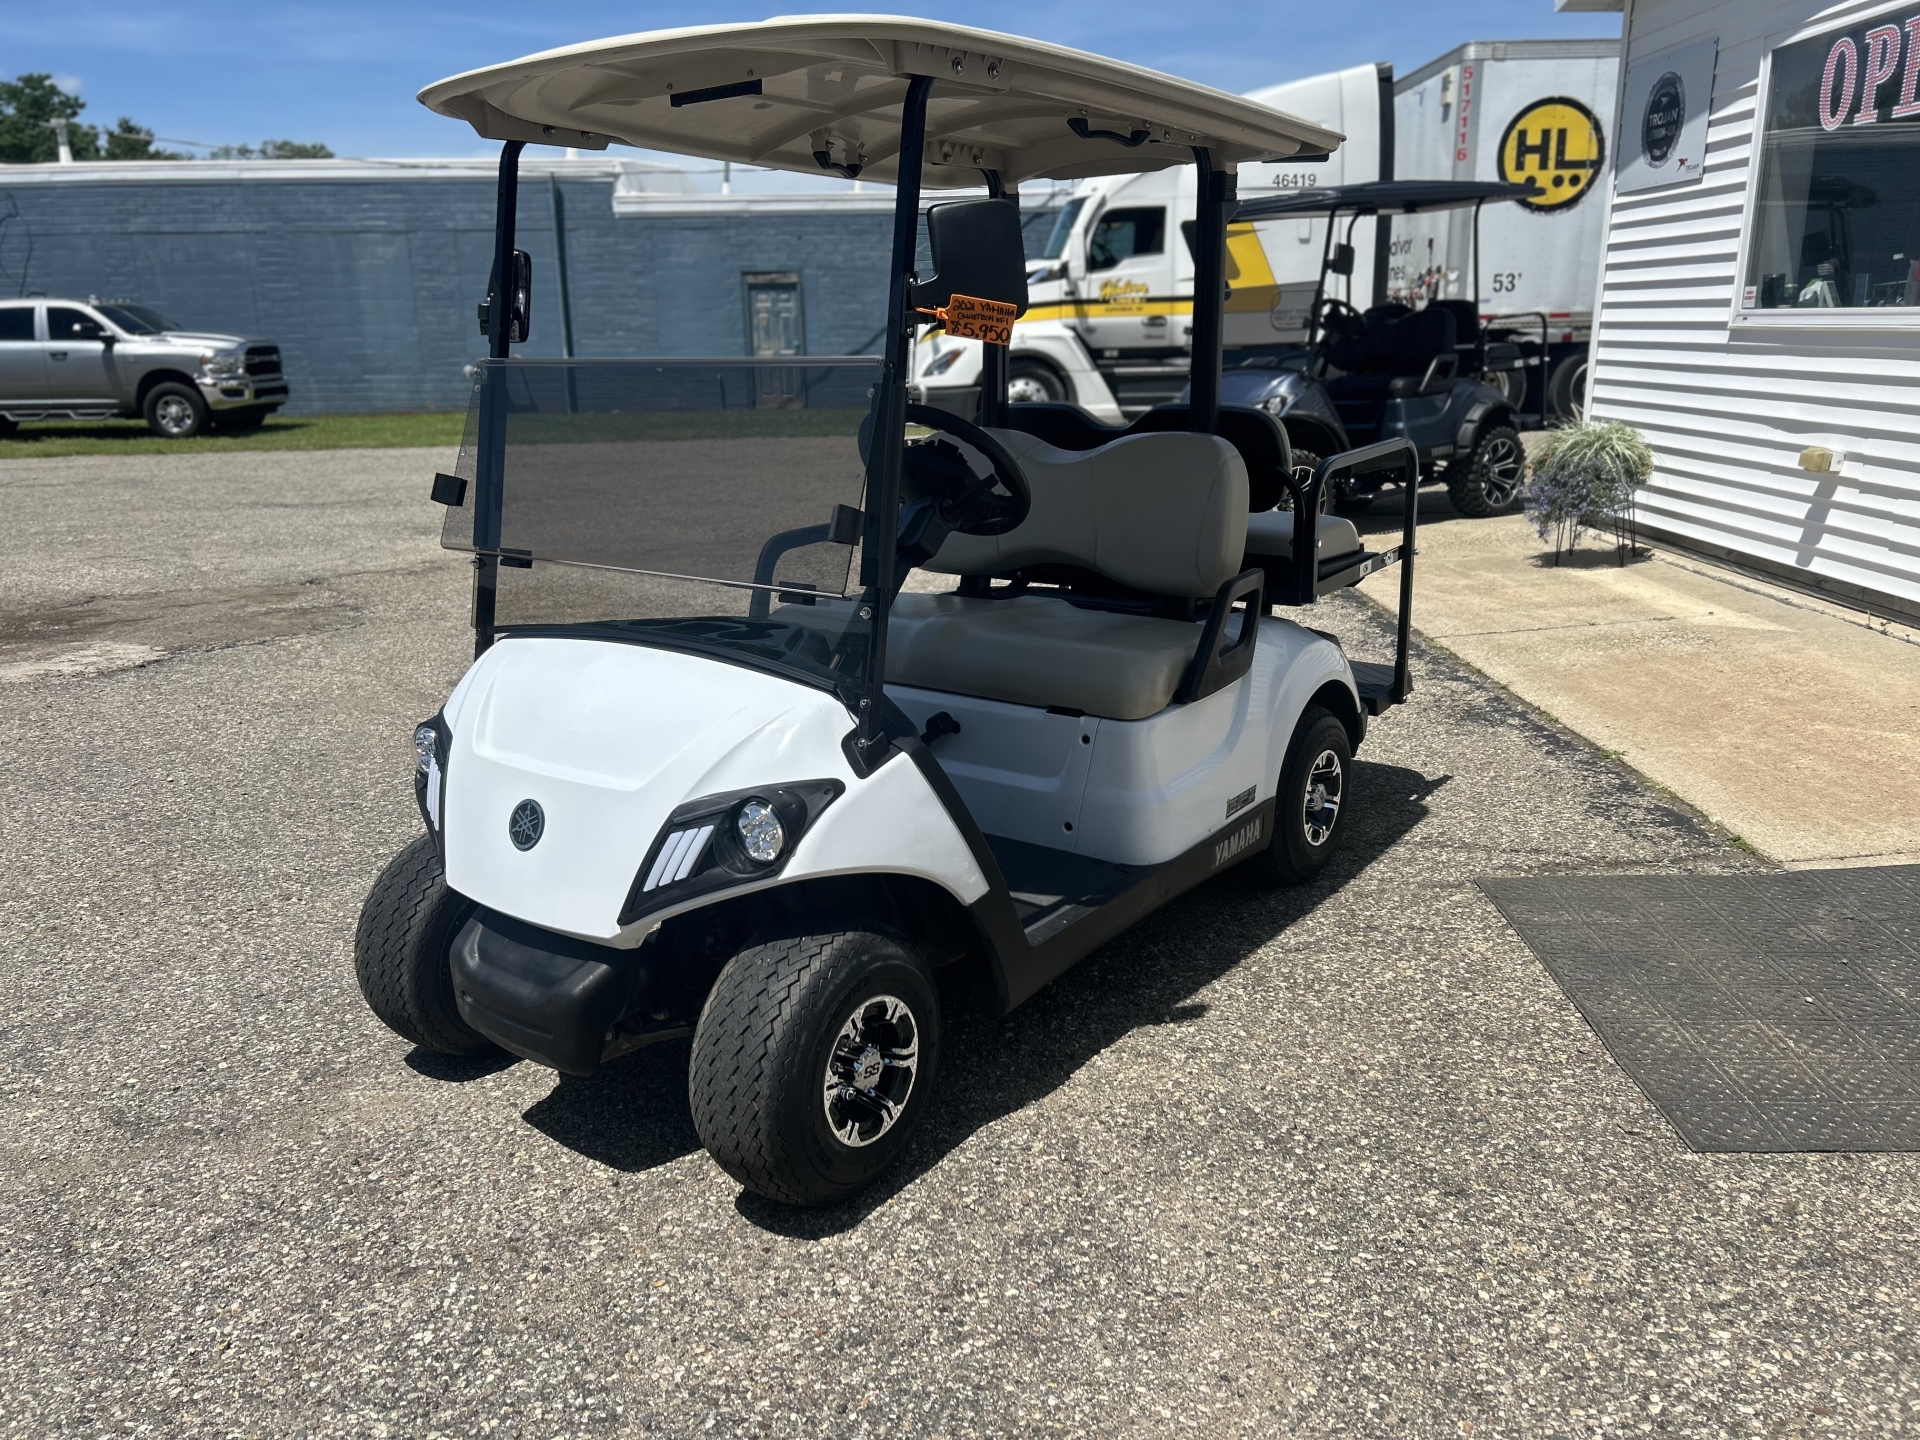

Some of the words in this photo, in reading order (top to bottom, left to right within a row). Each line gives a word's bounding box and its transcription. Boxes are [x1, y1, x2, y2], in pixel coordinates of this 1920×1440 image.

[1457, 66, 1474, 162] 517116
[1649, 107, 1679, 128] TROJAN
[1515, 128, 1599, 172] HL
[1272, 173, 1316, 188] 46419
[953, 299, 975, 311] 2021
[980, 302, 1015, 317] YAMAHA
[1215, 818, 1260, 867] YAMAHA
[863, 1061, 880, 1080] SS
